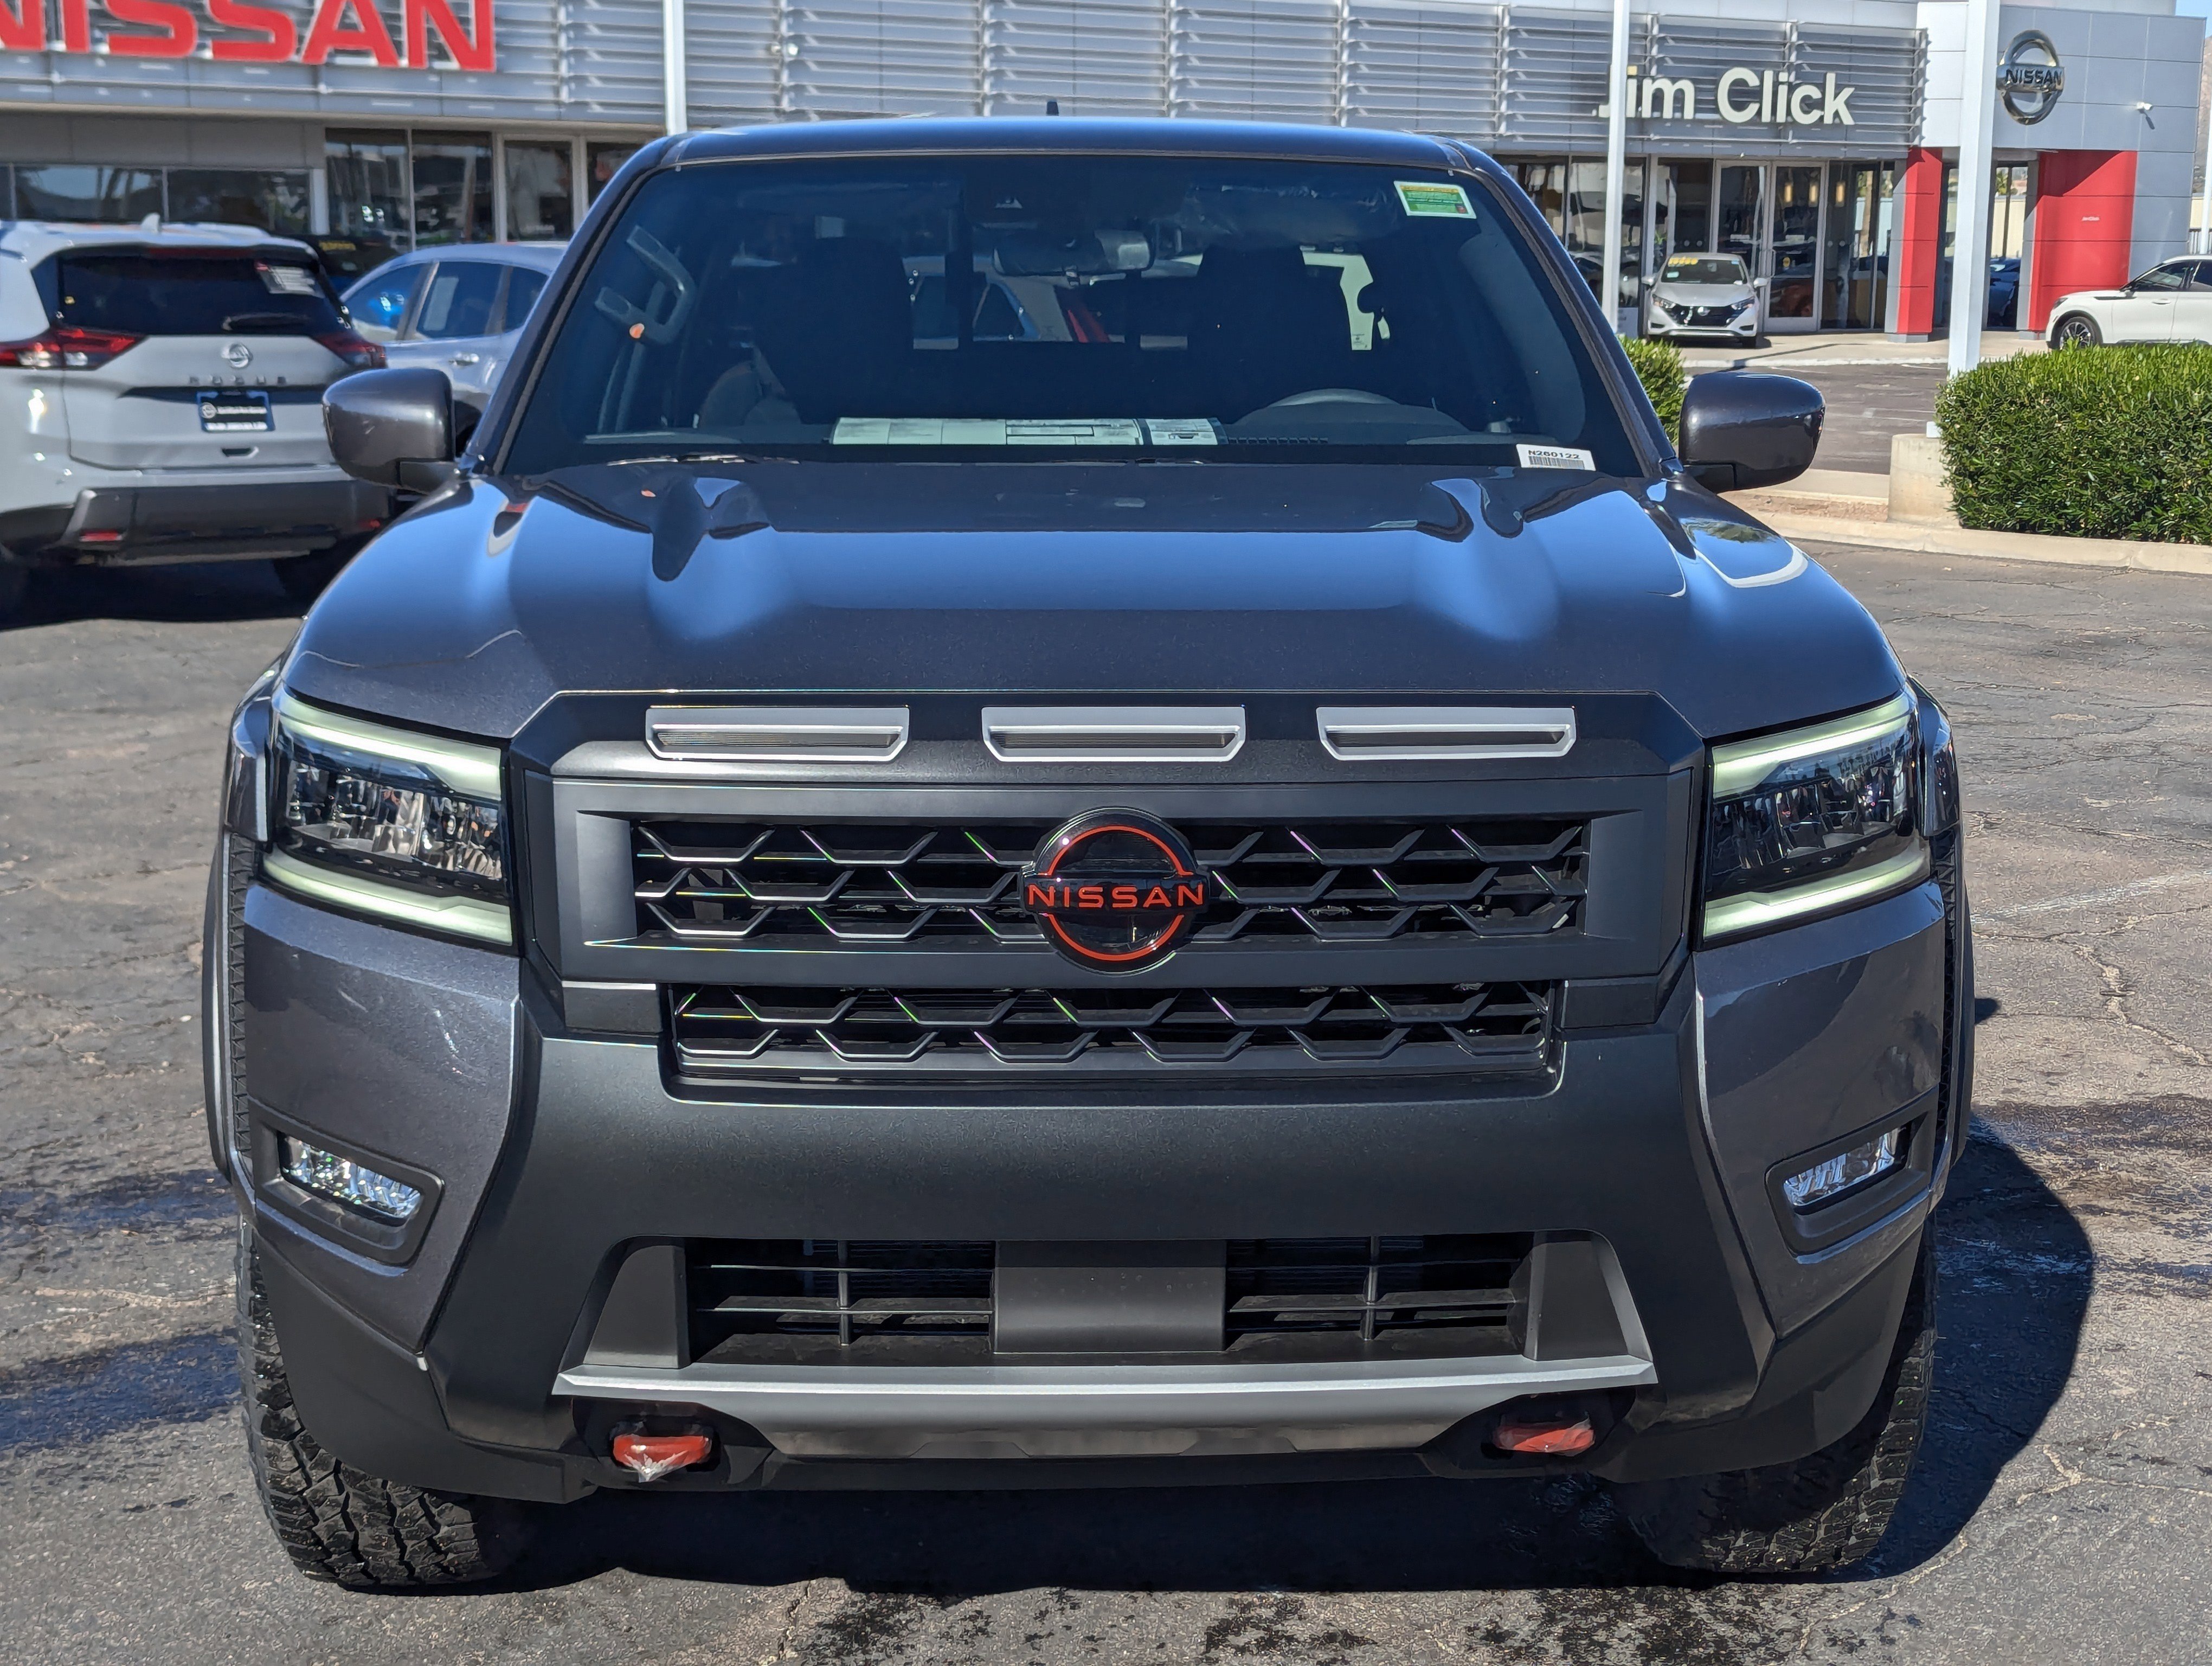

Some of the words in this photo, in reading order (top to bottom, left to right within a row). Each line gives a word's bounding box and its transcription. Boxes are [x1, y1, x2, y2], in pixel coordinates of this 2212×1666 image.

[2006, 68, 2062, 86] NISSAN
[1599, 66, 1695, 119] im
[1718, 67, 1855, 125] Click
[1028, 884, 1203, 908] NISSAN
